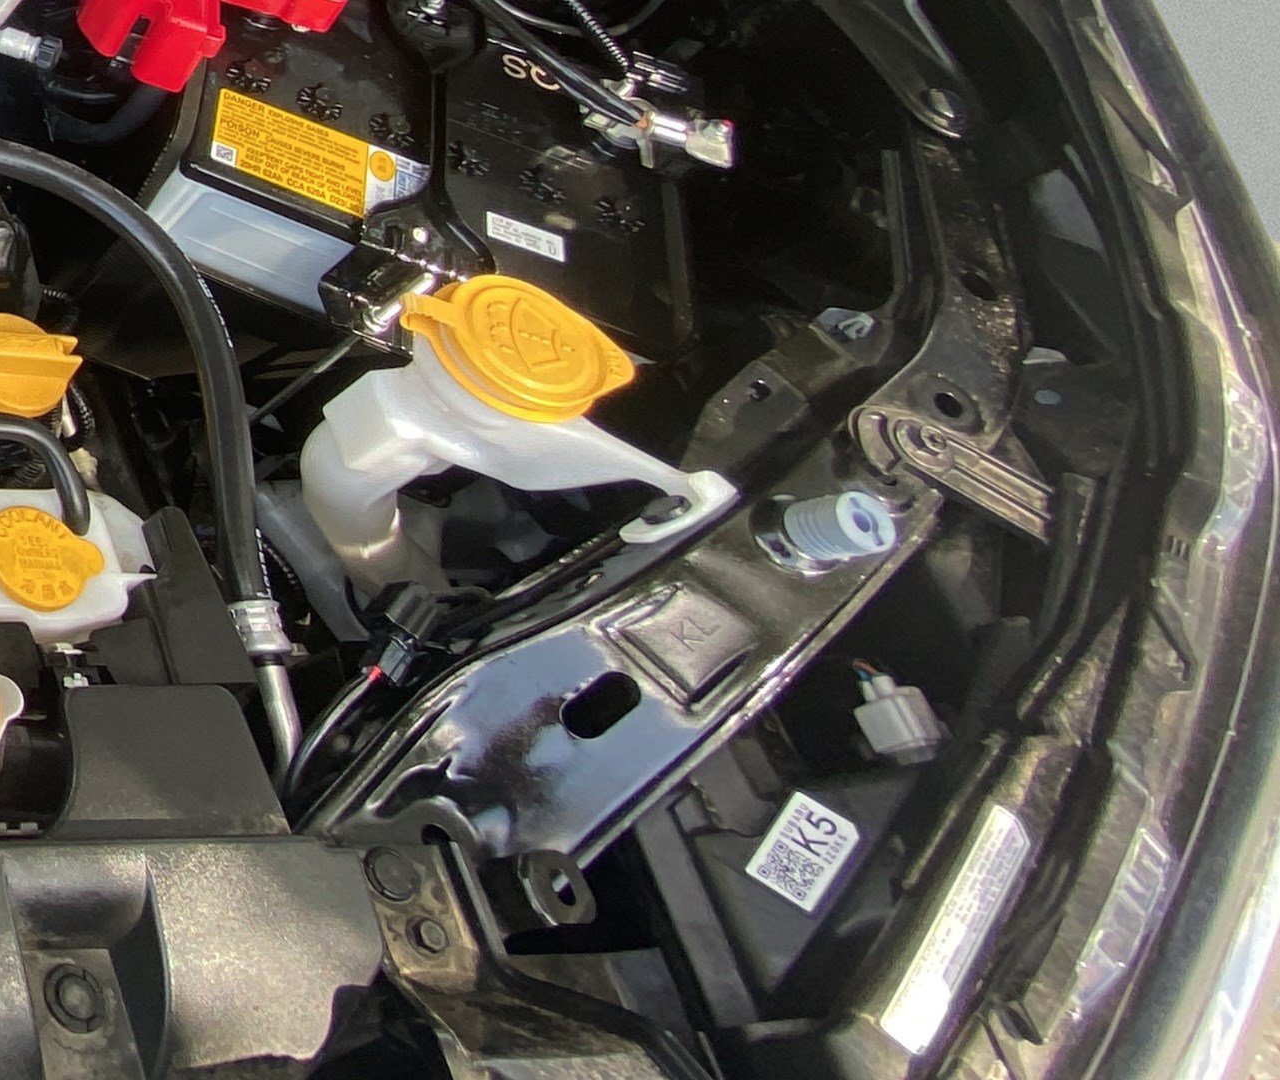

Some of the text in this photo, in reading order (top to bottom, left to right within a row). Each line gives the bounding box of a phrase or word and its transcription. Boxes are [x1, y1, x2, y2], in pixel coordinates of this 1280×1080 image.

[223, 91, 265, 112] DANGER
[219, 117, 260, 139] POISON
[790, 810, 838, 858] K5
